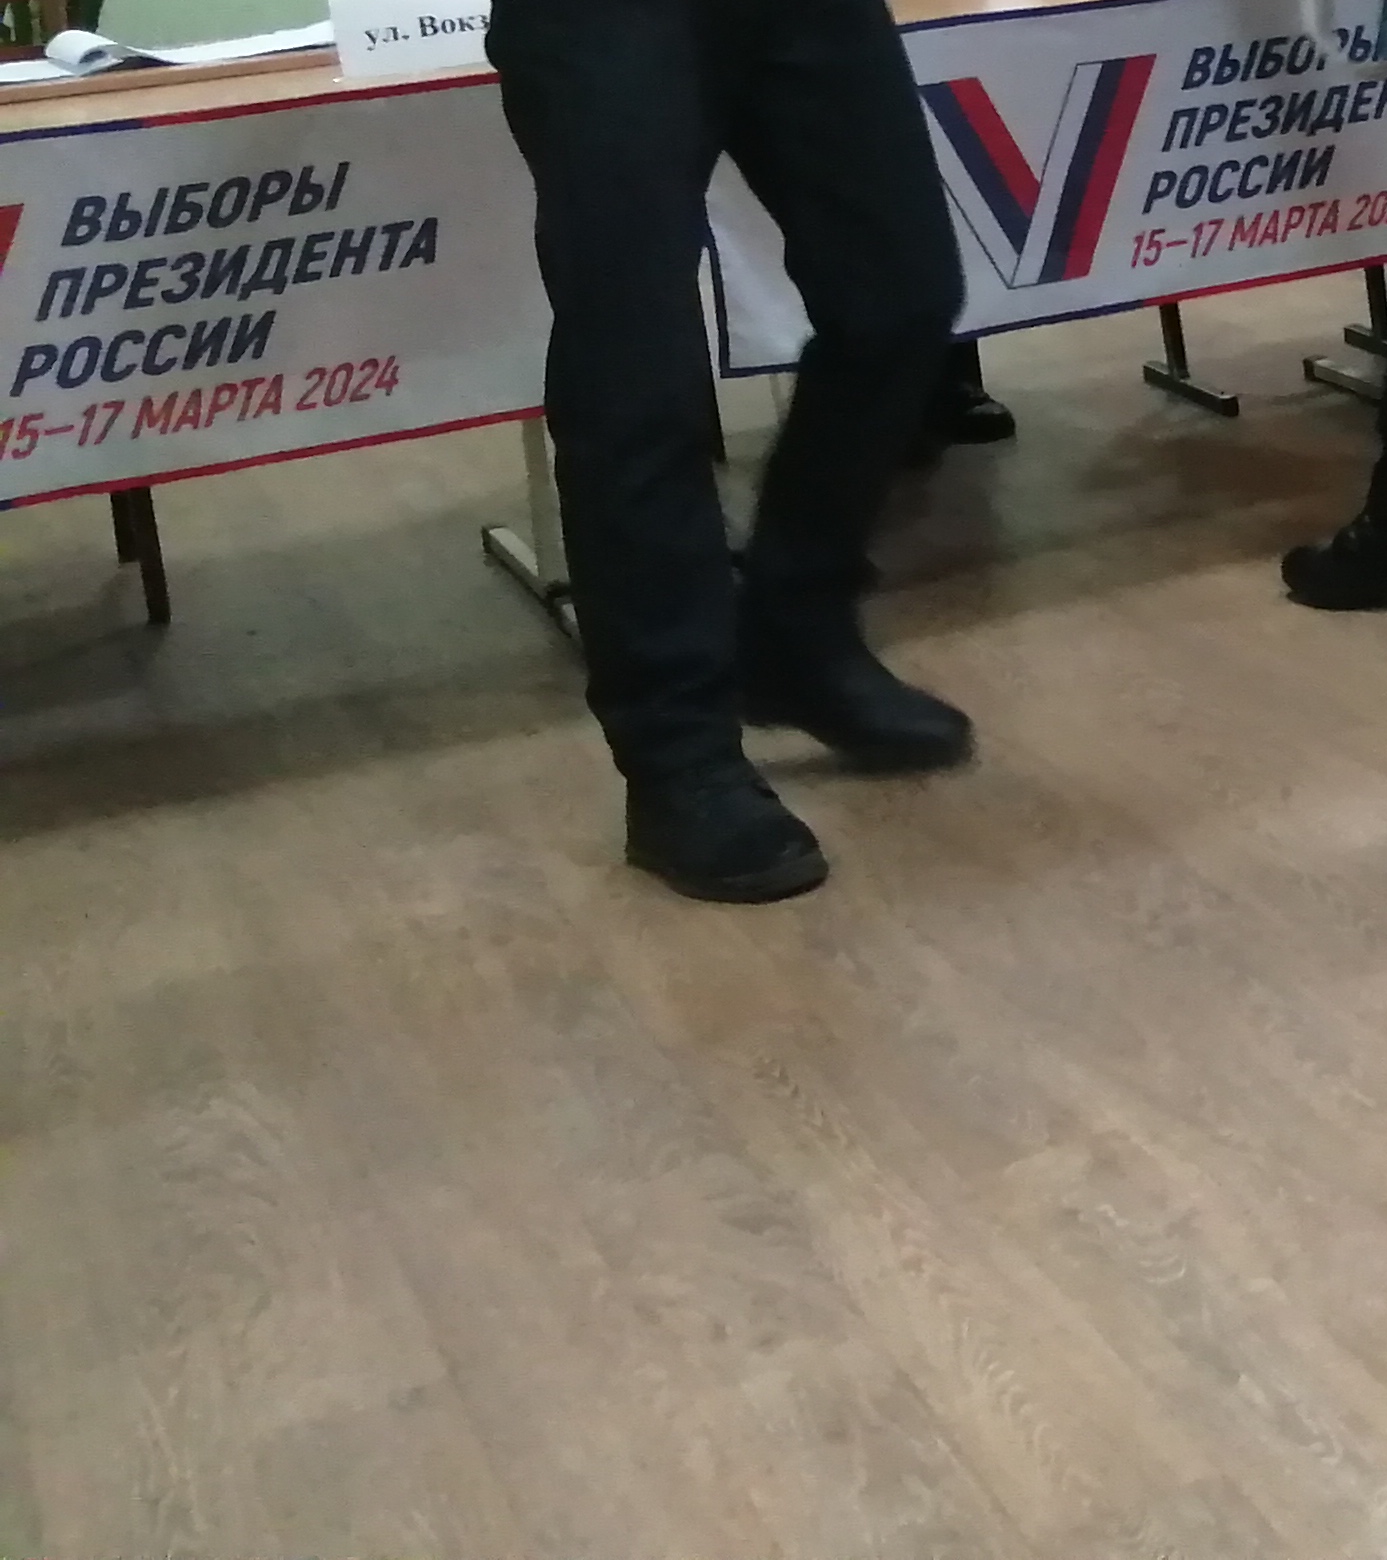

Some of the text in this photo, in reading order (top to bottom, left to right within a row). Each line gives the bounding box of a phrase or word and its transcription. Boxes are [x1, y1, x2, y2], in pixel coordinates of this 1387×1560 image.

[365, 14, 489, 51] ул. Вокз
[61, 162, 350, 248] ВЫБОРЫ
[1142, 145, 1336, 214] РОССИИ
[1228, 201, 1340, 252] МАРТА
[35, 217, 439, 322] ПРЕЗИДЕНТА
[10, 311, 277, 397] РОССИИ
[130, 374, 285, 439] МАРТА
[296, 355, 401, 412] 2024
